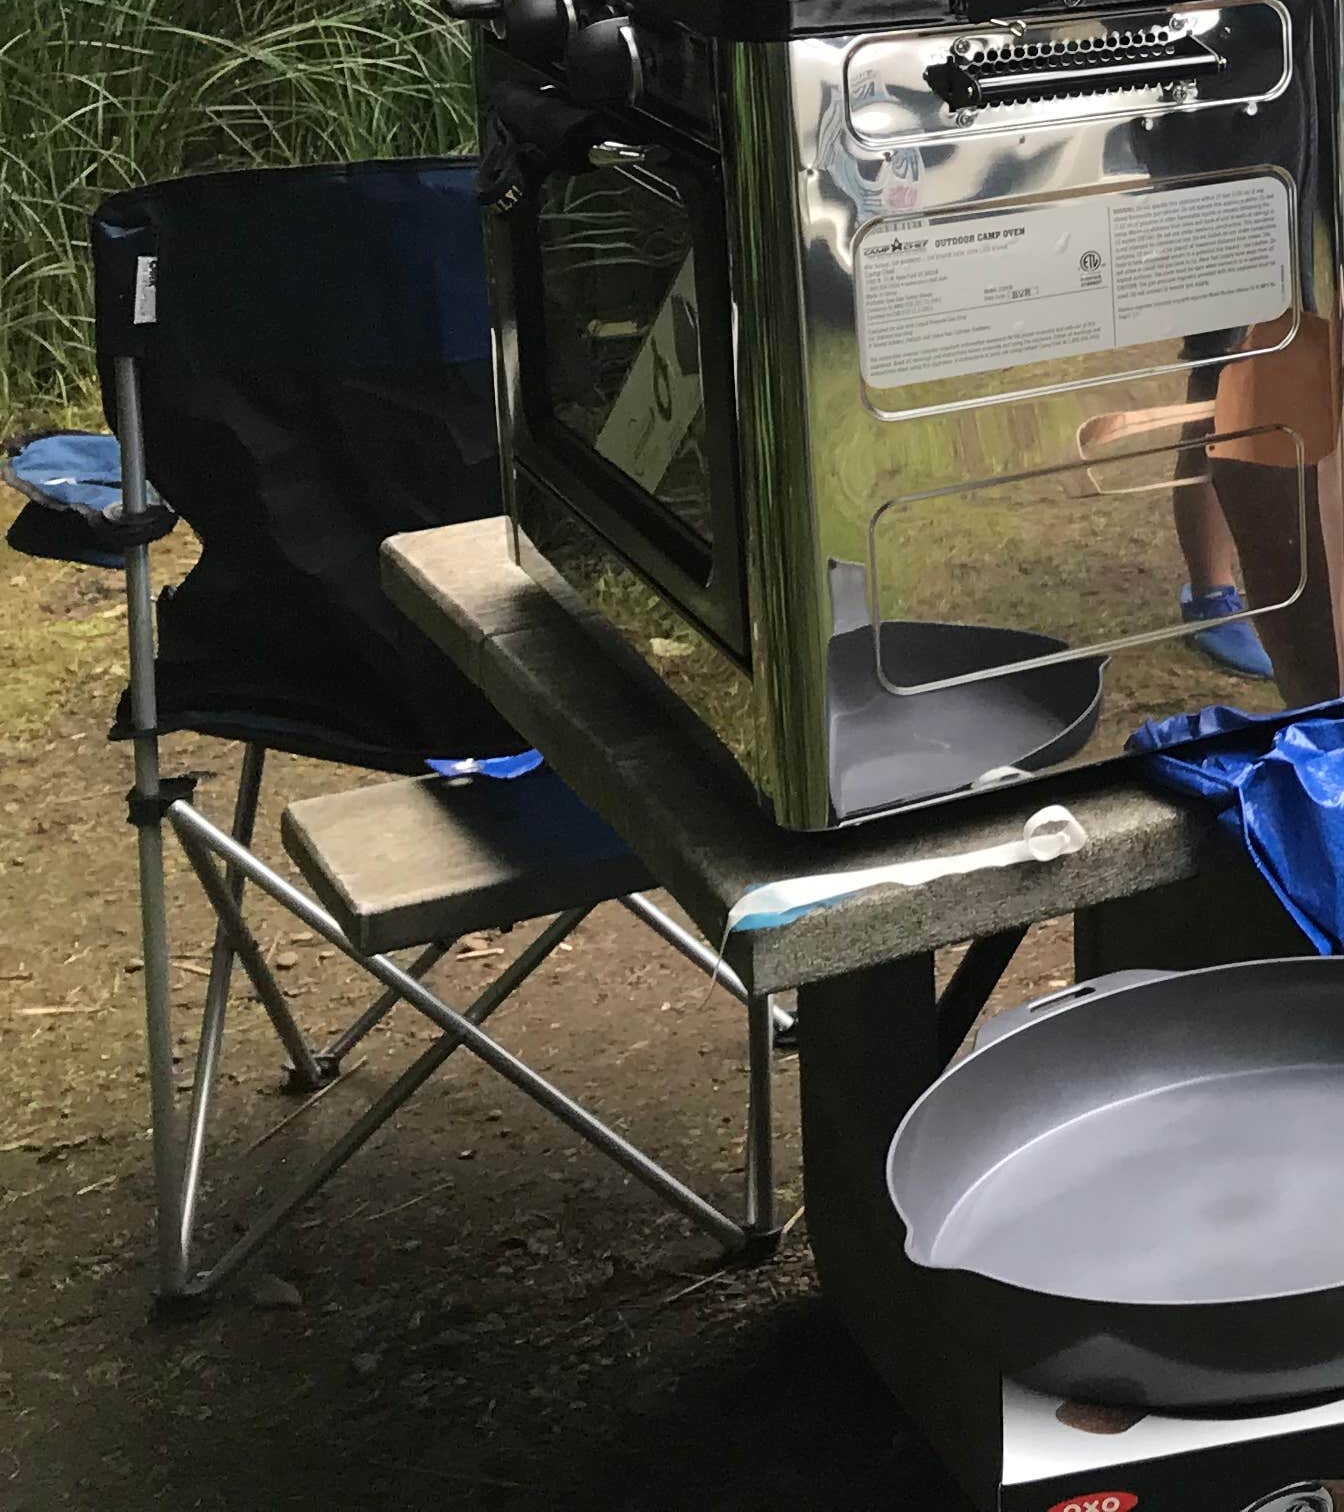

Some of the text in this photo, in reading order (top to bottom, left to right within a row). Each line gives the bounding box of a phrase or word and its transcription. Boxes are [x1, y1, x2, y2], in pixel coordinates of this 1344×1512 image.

[935, 227, 1025, 248] OUTDOOR CAMP OVEN
[1063, 1496, 1121, 1512] OXO
